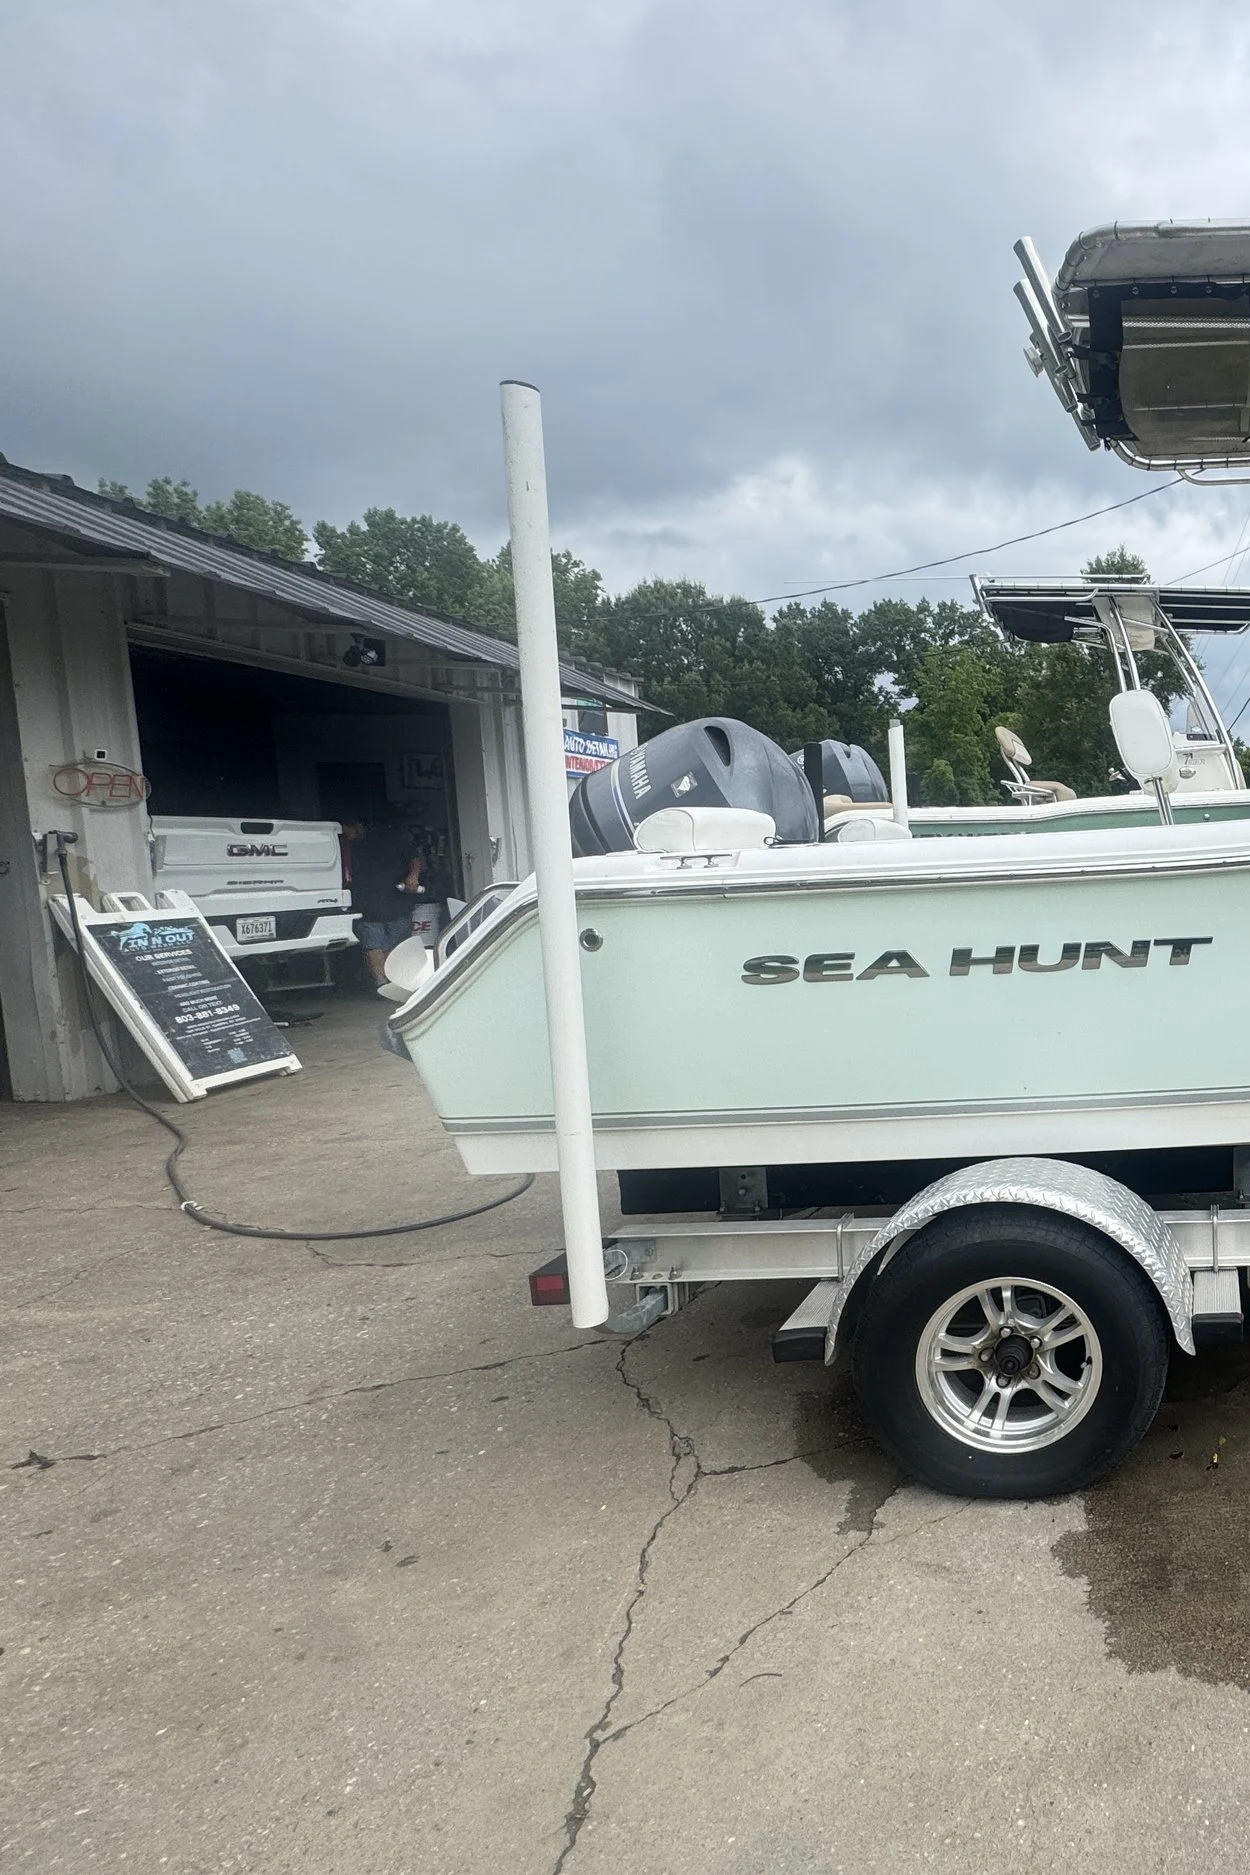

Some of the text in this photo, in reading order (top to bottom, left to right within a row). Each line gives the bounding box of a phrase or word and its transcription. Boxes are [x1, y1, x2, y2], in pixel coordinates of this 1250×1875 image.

[564, 735, 585, 753] AUTO
[53, 767, 144, 799] OPEN
[629, 749, 652, 800] YAMAHA
[227, 844, 288, 857] GMC
[241, 921, 272, 935] X676371
[128, 932, 194, 947] IN N OUT
[135, 954, 154, 962] OUR
[154, 949, 193, 959] SERVICES
[740, 936, 1214, 986] SEA HUNT
[175, 1004, 240, 1024] 803-881-8349
